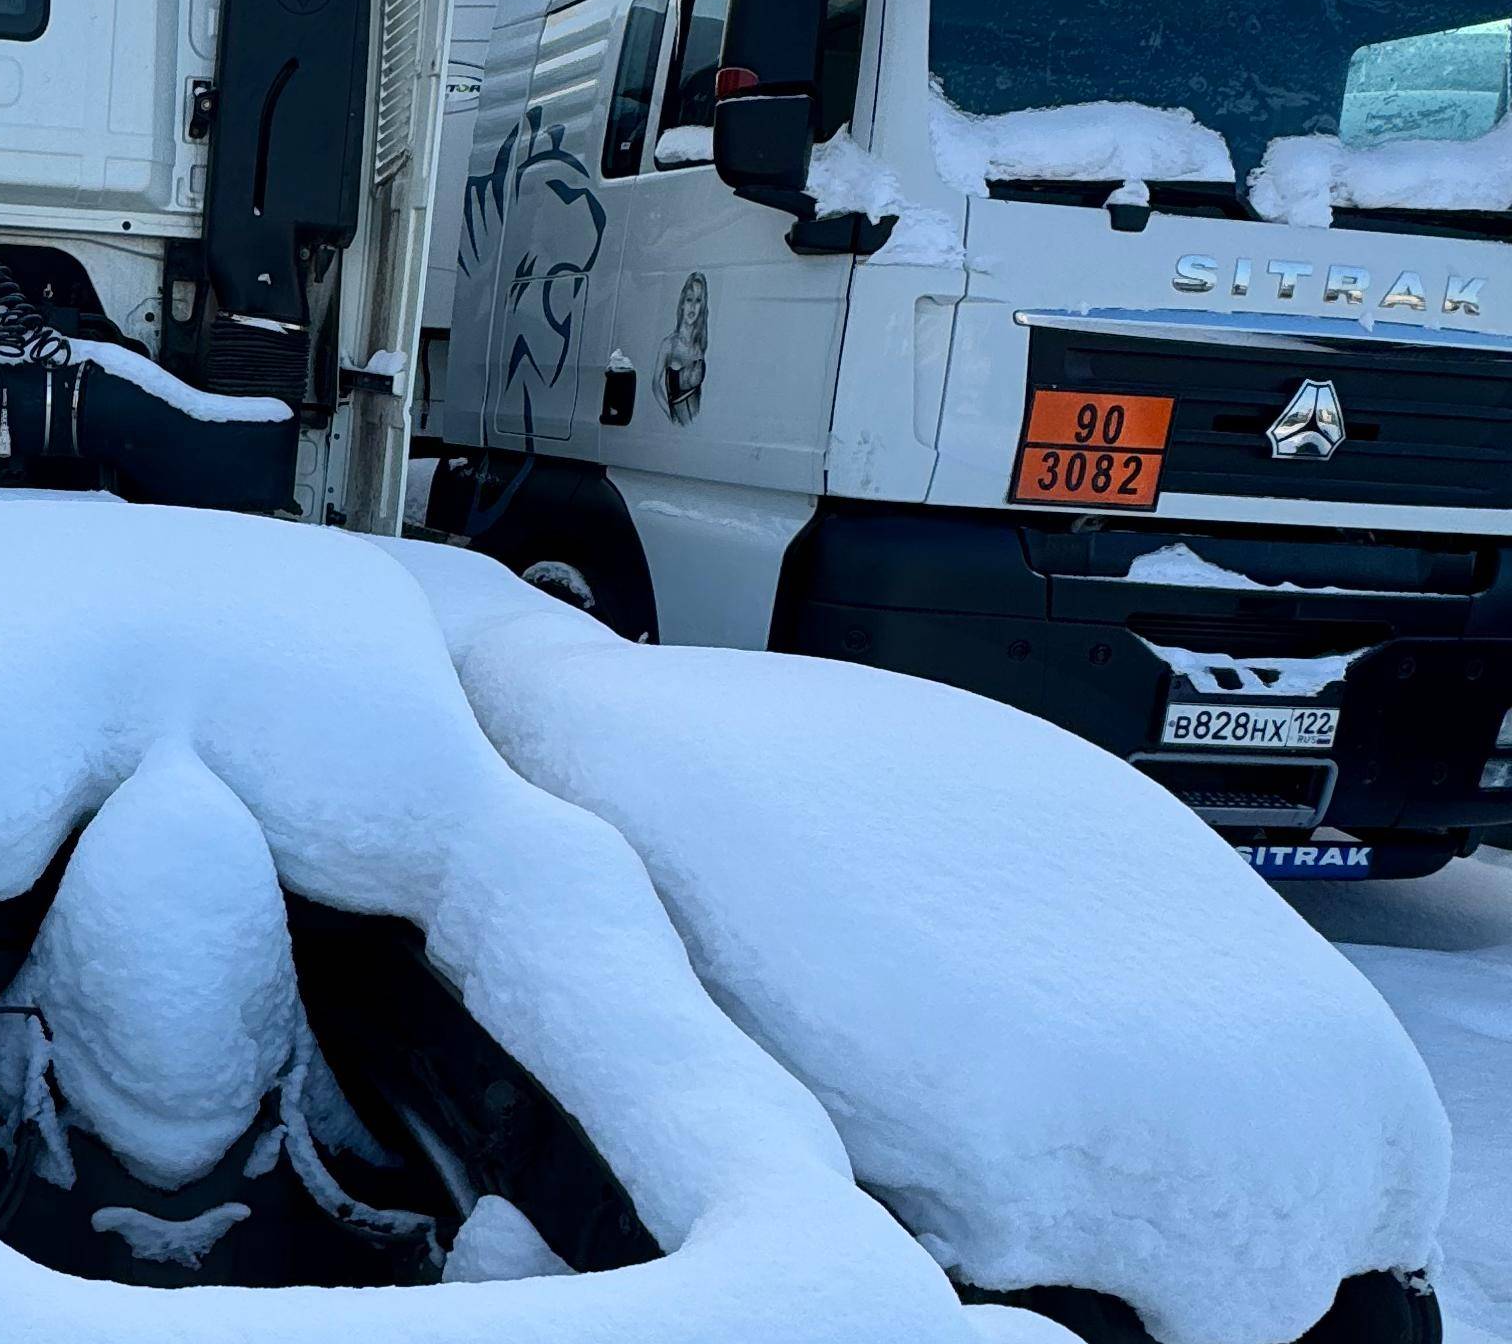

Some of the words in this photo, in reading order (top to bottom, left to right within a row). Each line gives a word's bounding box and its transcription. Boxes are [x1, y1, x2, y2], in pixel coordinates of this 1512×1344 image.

[1171, 253, 1488, 316] SITRAK
[1074, 403, 1125, 445] 90
[1037, 451, 1143, 495] 3082
[1293, 711, 1331, 735] 122
